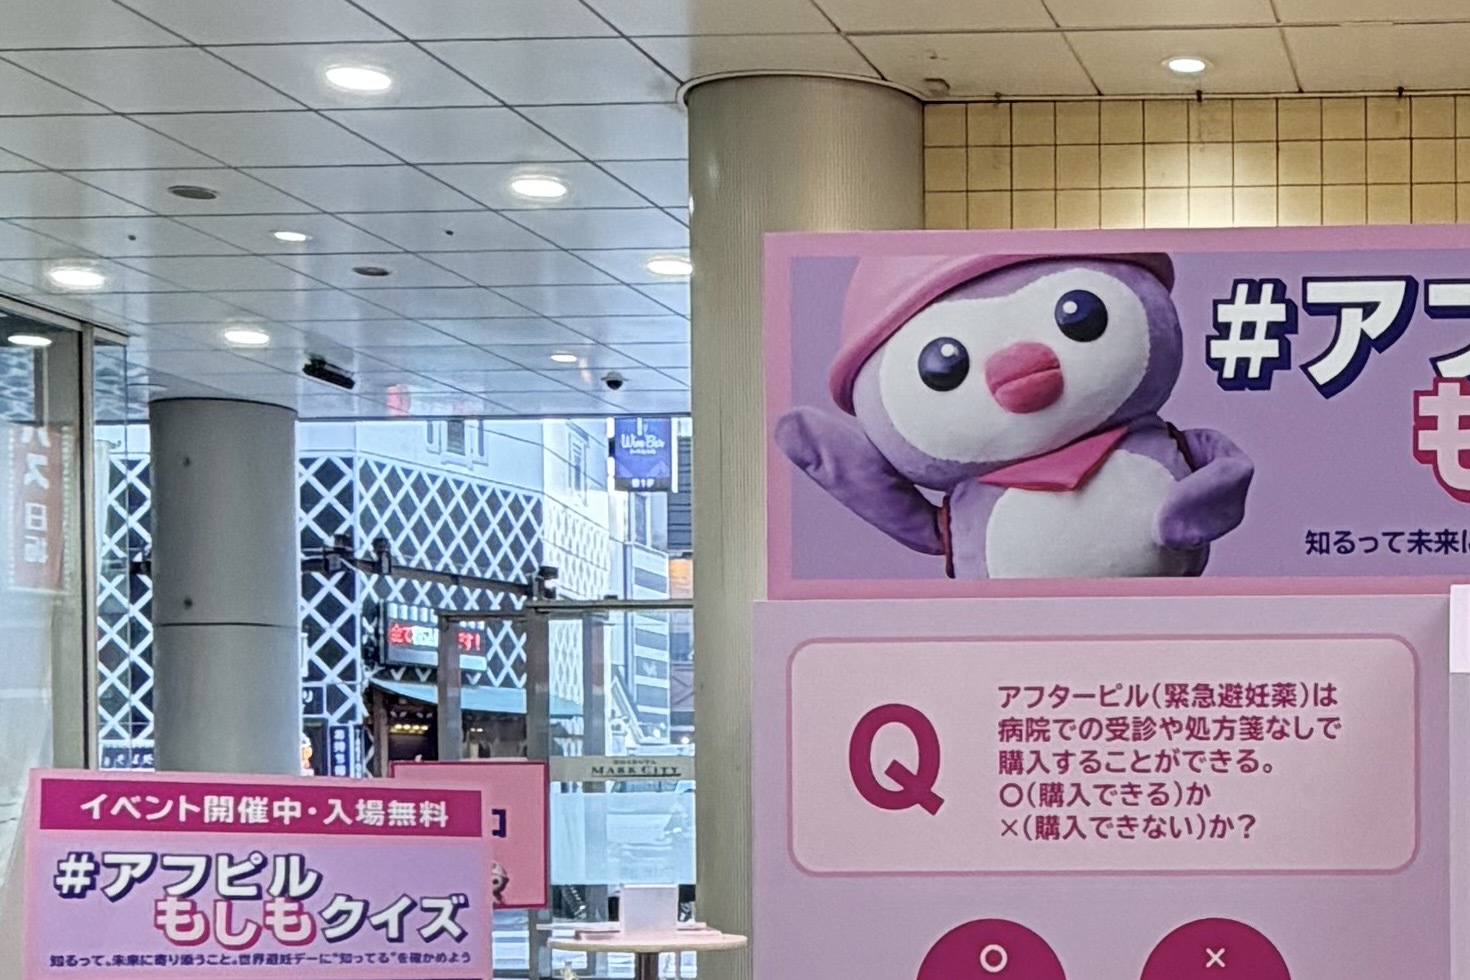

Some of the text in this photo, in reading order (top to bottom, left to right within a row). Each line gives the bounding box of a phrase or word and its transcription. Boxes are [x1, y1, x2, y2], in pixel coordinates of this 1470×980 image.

[998, 682, 1339, 710] アフターピル(緊急避妊薬)は
[997, 715, 1343, 743] 病院での受診や処方箋なしで
[849, 703, 945, 816] Q
[998, 748, 1274, 776] 購入することができる。
[79, 793, 449, 828] イベント開催中・入場無料
[54, 850, 324, 902] #アフピル
[154, 893, 469, 950] もしもクイズ
